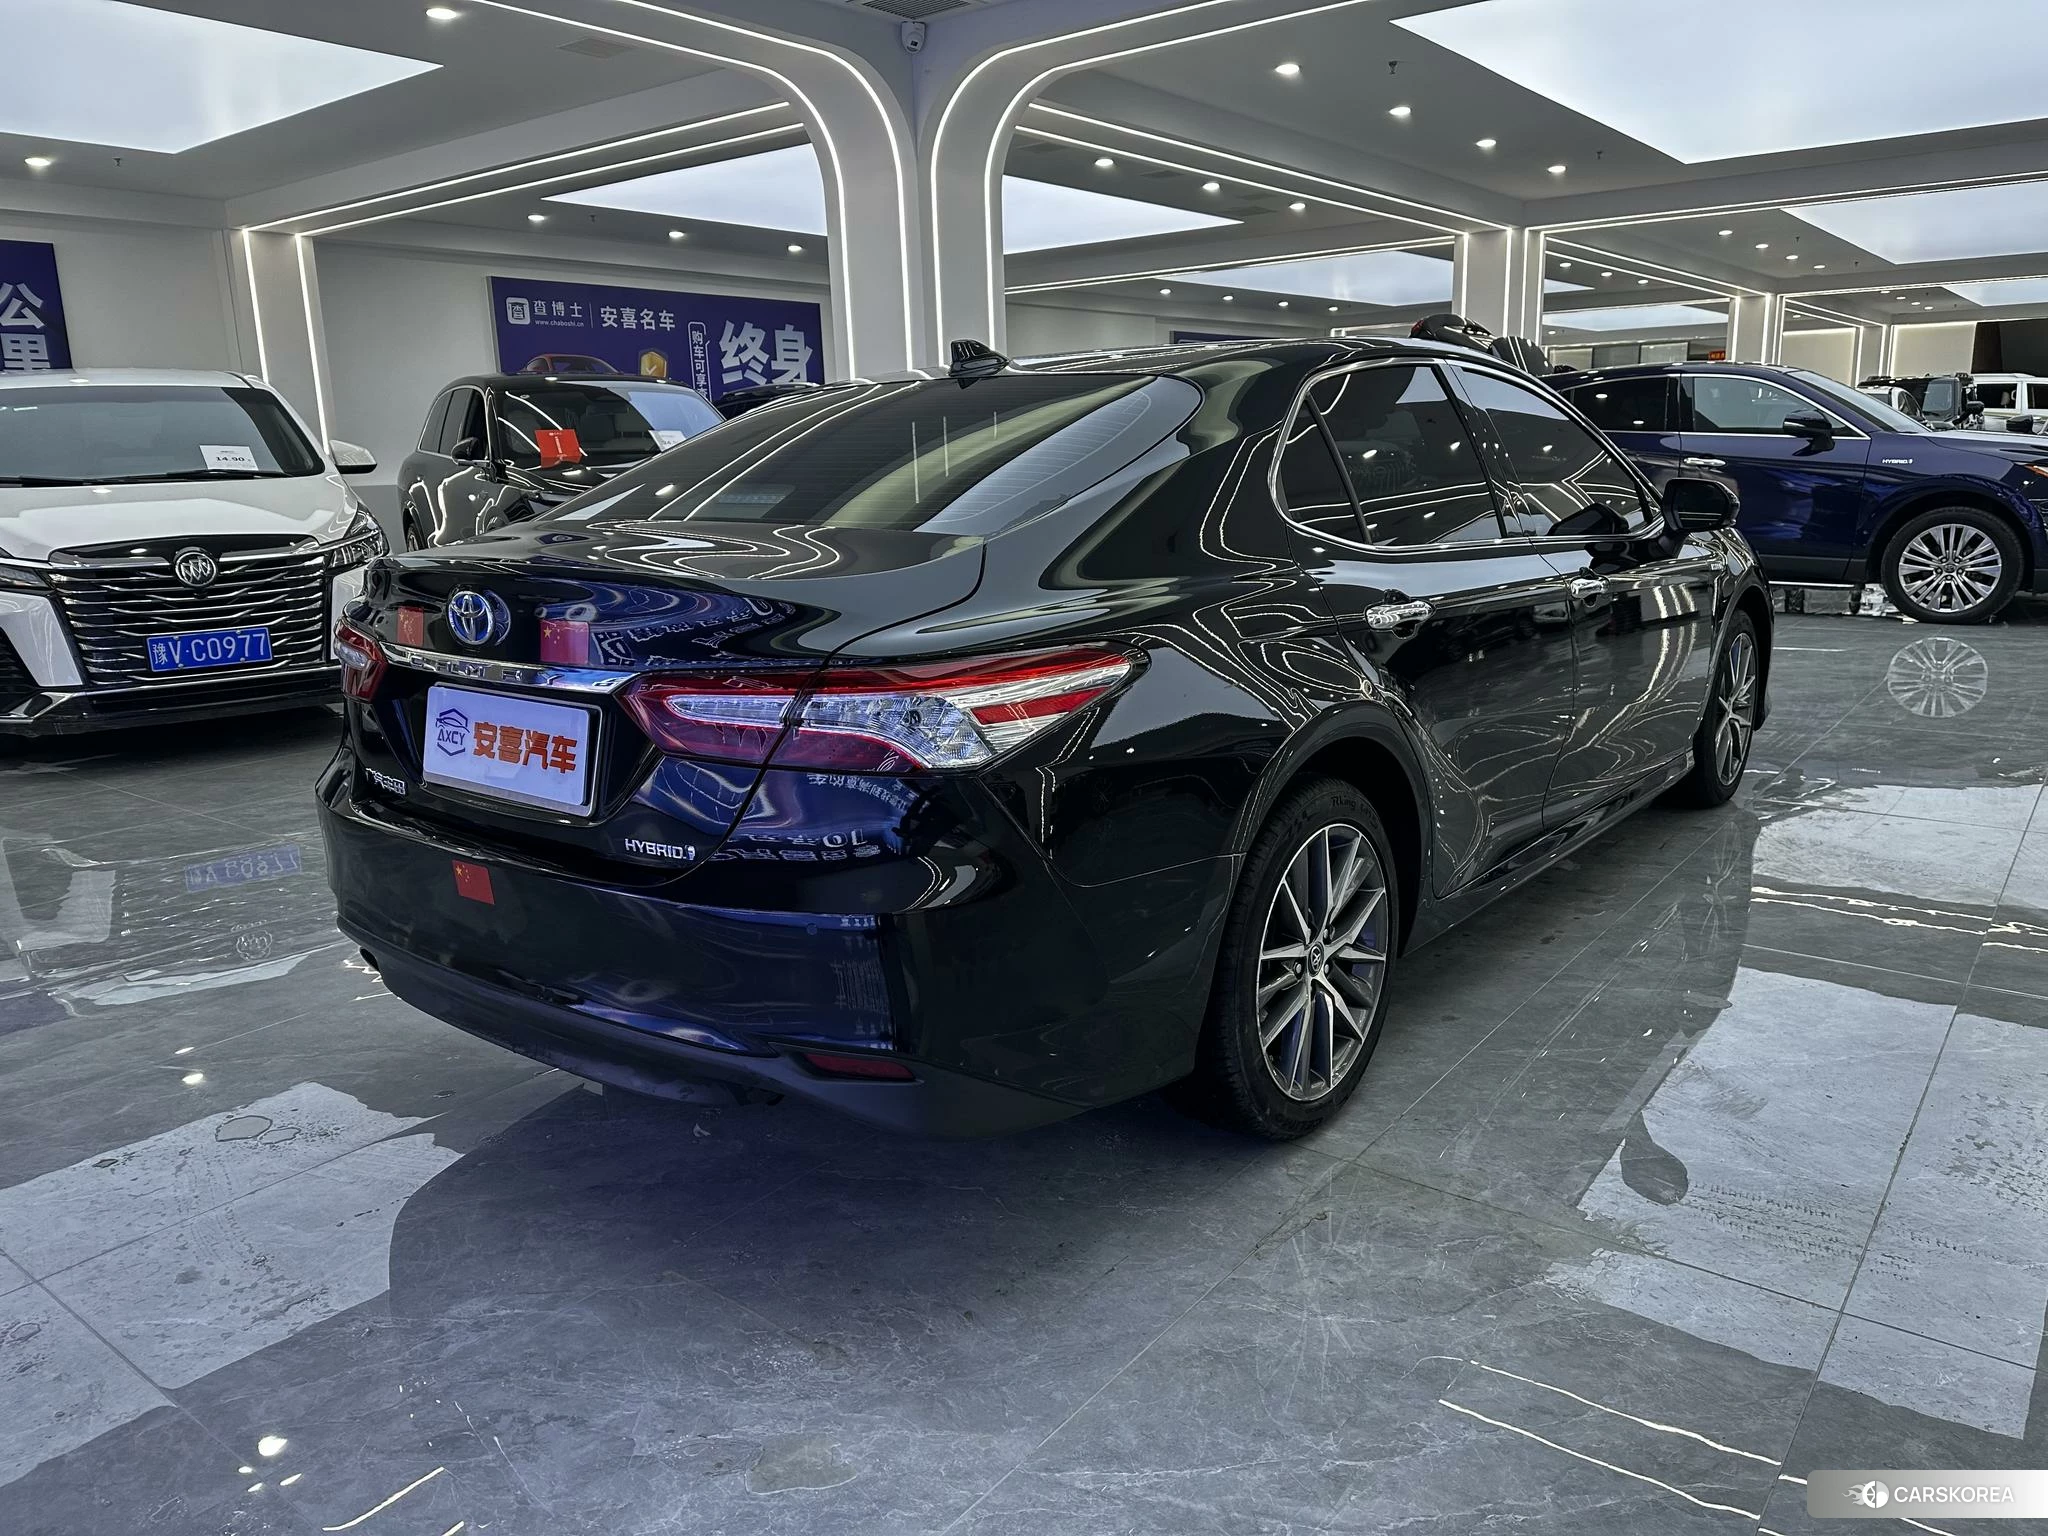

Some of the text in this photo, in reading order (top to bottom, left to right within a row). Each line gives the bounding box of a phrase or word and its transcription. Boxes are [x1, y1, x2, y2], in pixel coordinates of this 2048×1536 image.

[533, 300, 583, 317] 查博士
[600, 306, 676, 331] 安喜名车
[719, 320, 813, 385] 终身
[473, 721, 577, 774] 安喜汽车
[624, 838, 684, 859] HYBRID
